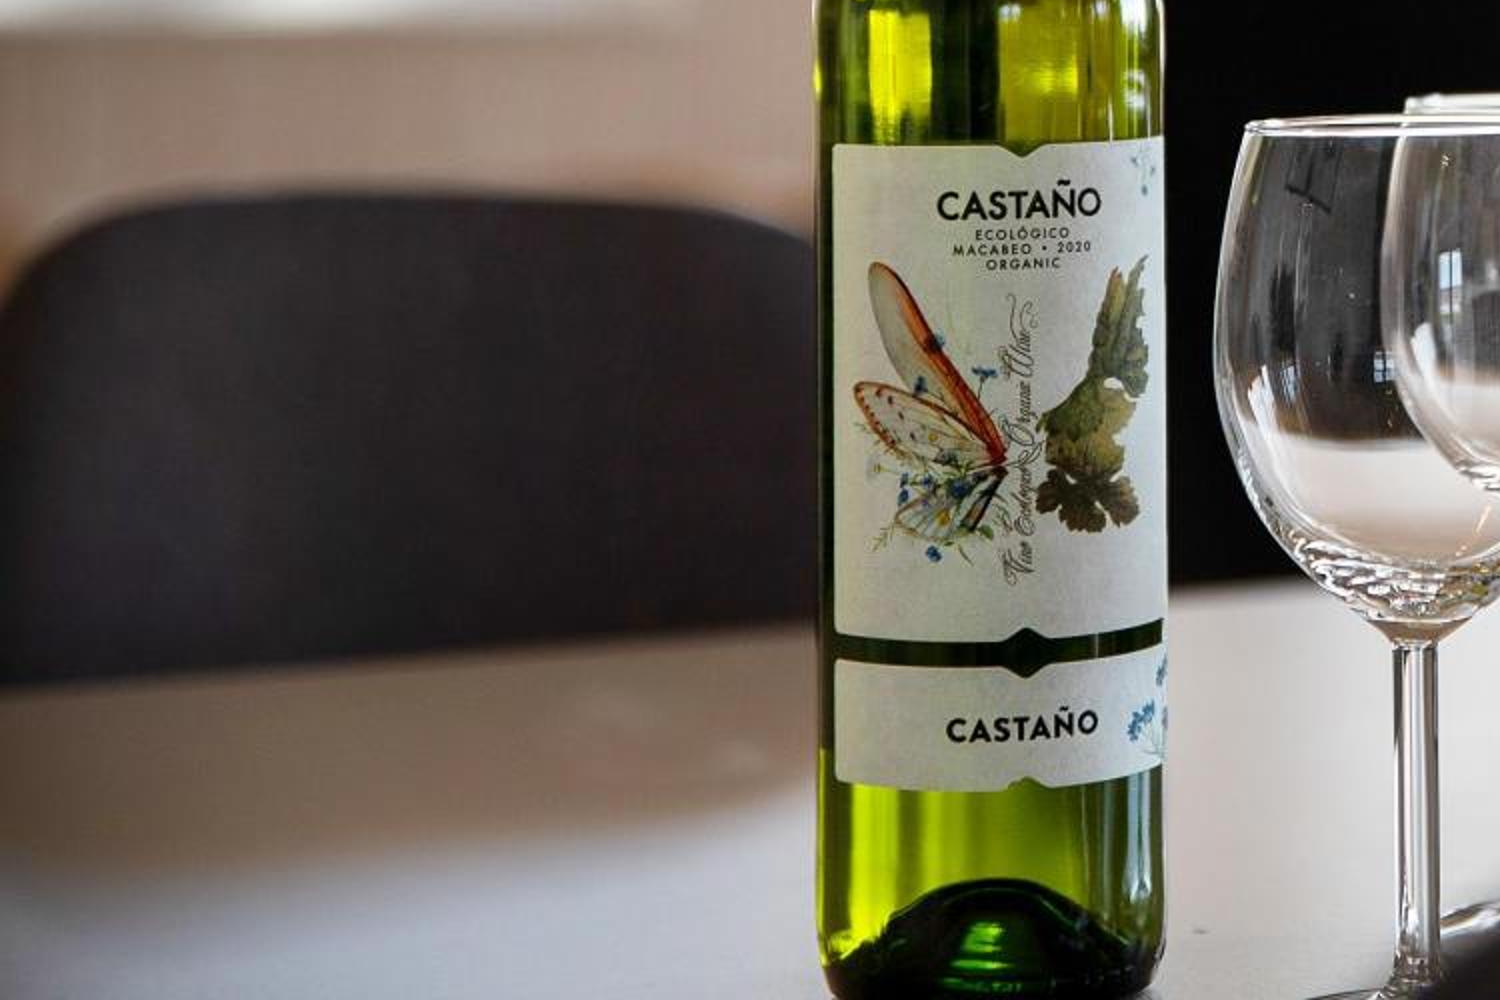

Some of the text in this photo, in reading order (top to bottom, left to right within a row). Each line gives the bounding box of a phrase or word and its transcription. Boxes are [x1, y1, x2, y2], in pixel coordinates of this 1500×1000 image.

[937, 179, 1102, 221] CASTAÑO
[975, 226, 1070, 241] ECOLÓGICO
[952, 241, 1091, 257] MACABEO 2020
[985, 257, 1061, 271] ORGANIC
[945, 705, 1099, 743] CASTAÑO
